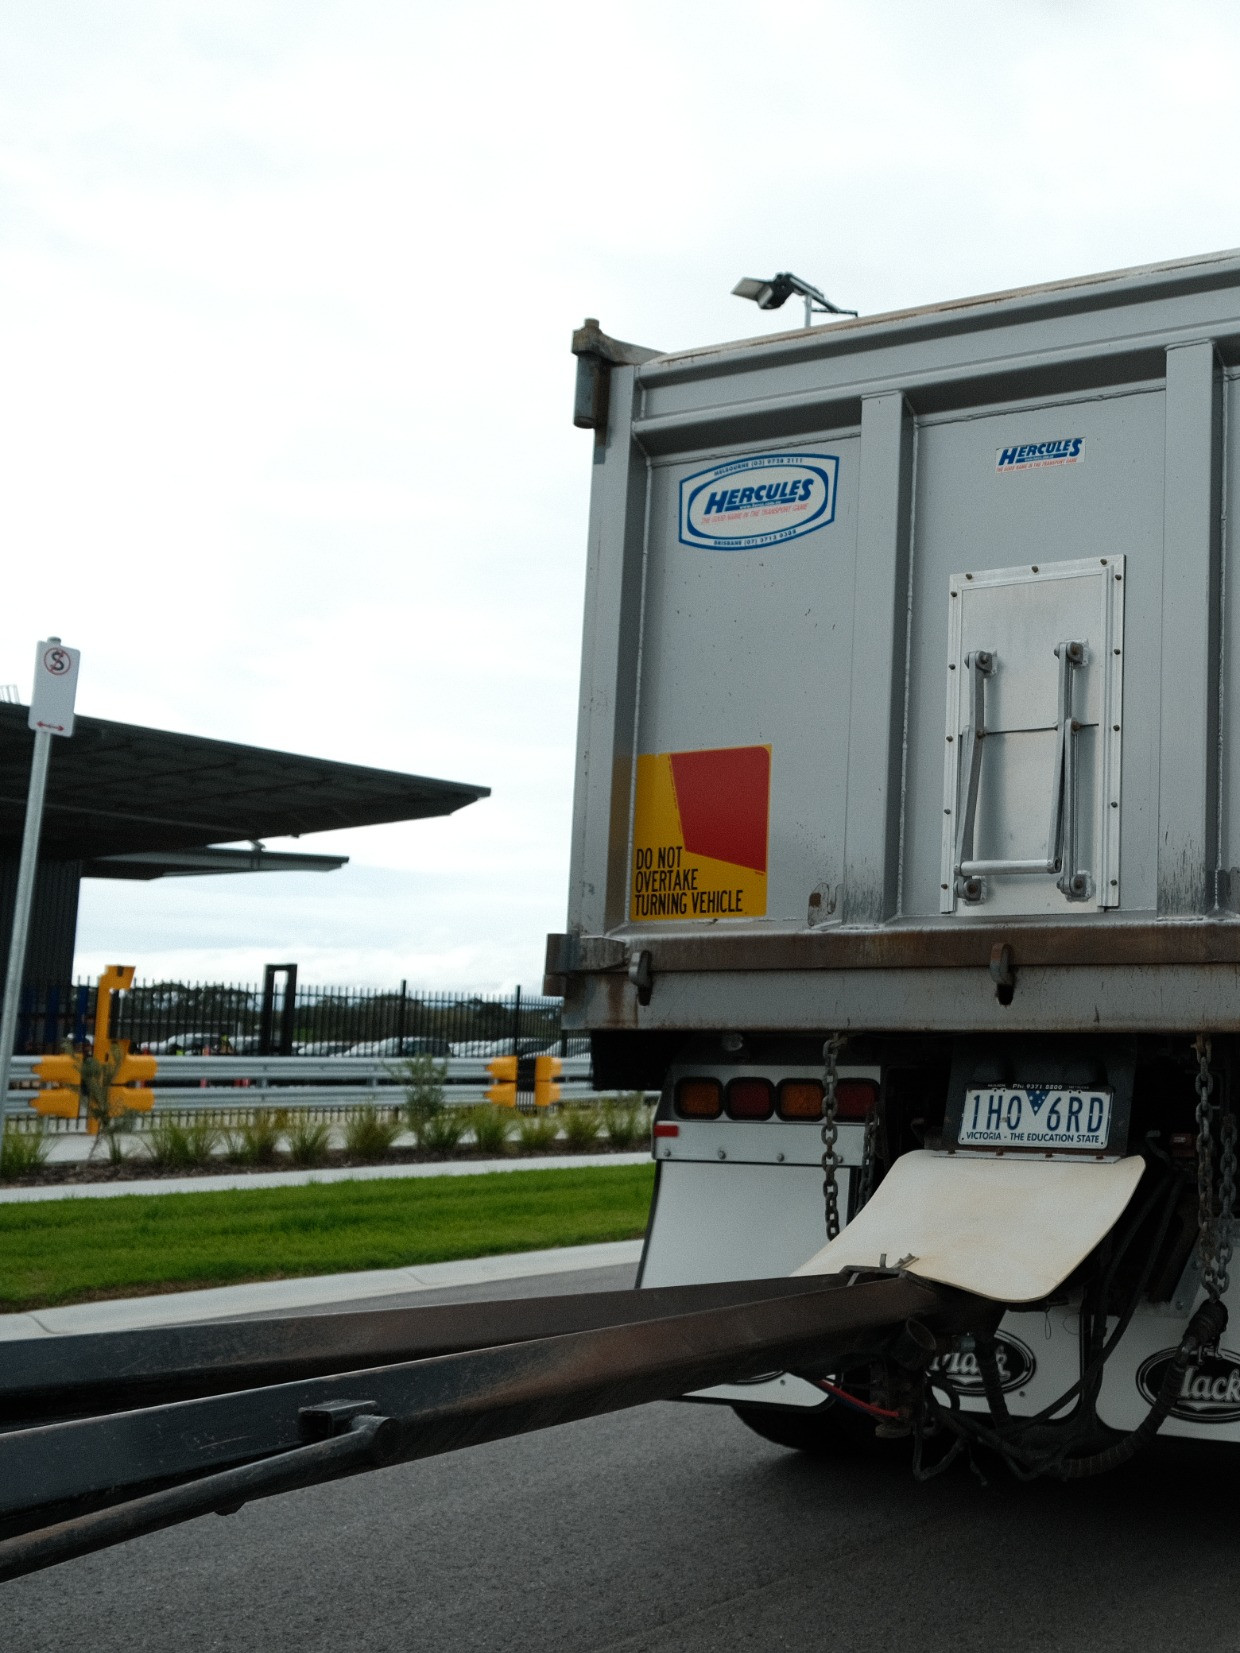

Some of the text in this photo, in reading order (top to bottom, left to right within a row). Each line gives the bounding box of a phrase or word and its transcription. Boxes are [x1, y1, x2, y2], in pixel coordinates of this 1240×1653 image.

[998, 438, 1083, 466] HERCULES
[704, 478, 815, 515] HERCULES
[636, 846, 683, 870] DO NOT
[635, 868, 699, 893] OVERTAKE
[635, 889, 744, 916] TURNING VEHICLE
[966, 1131, 1001, 1141] VICTORIA
[1010, 1132, 1025, 1141] THE
[1027, 1132, 1074, 1143] EDUCATION
[1076, 1134, 1100, 1144] STATE
